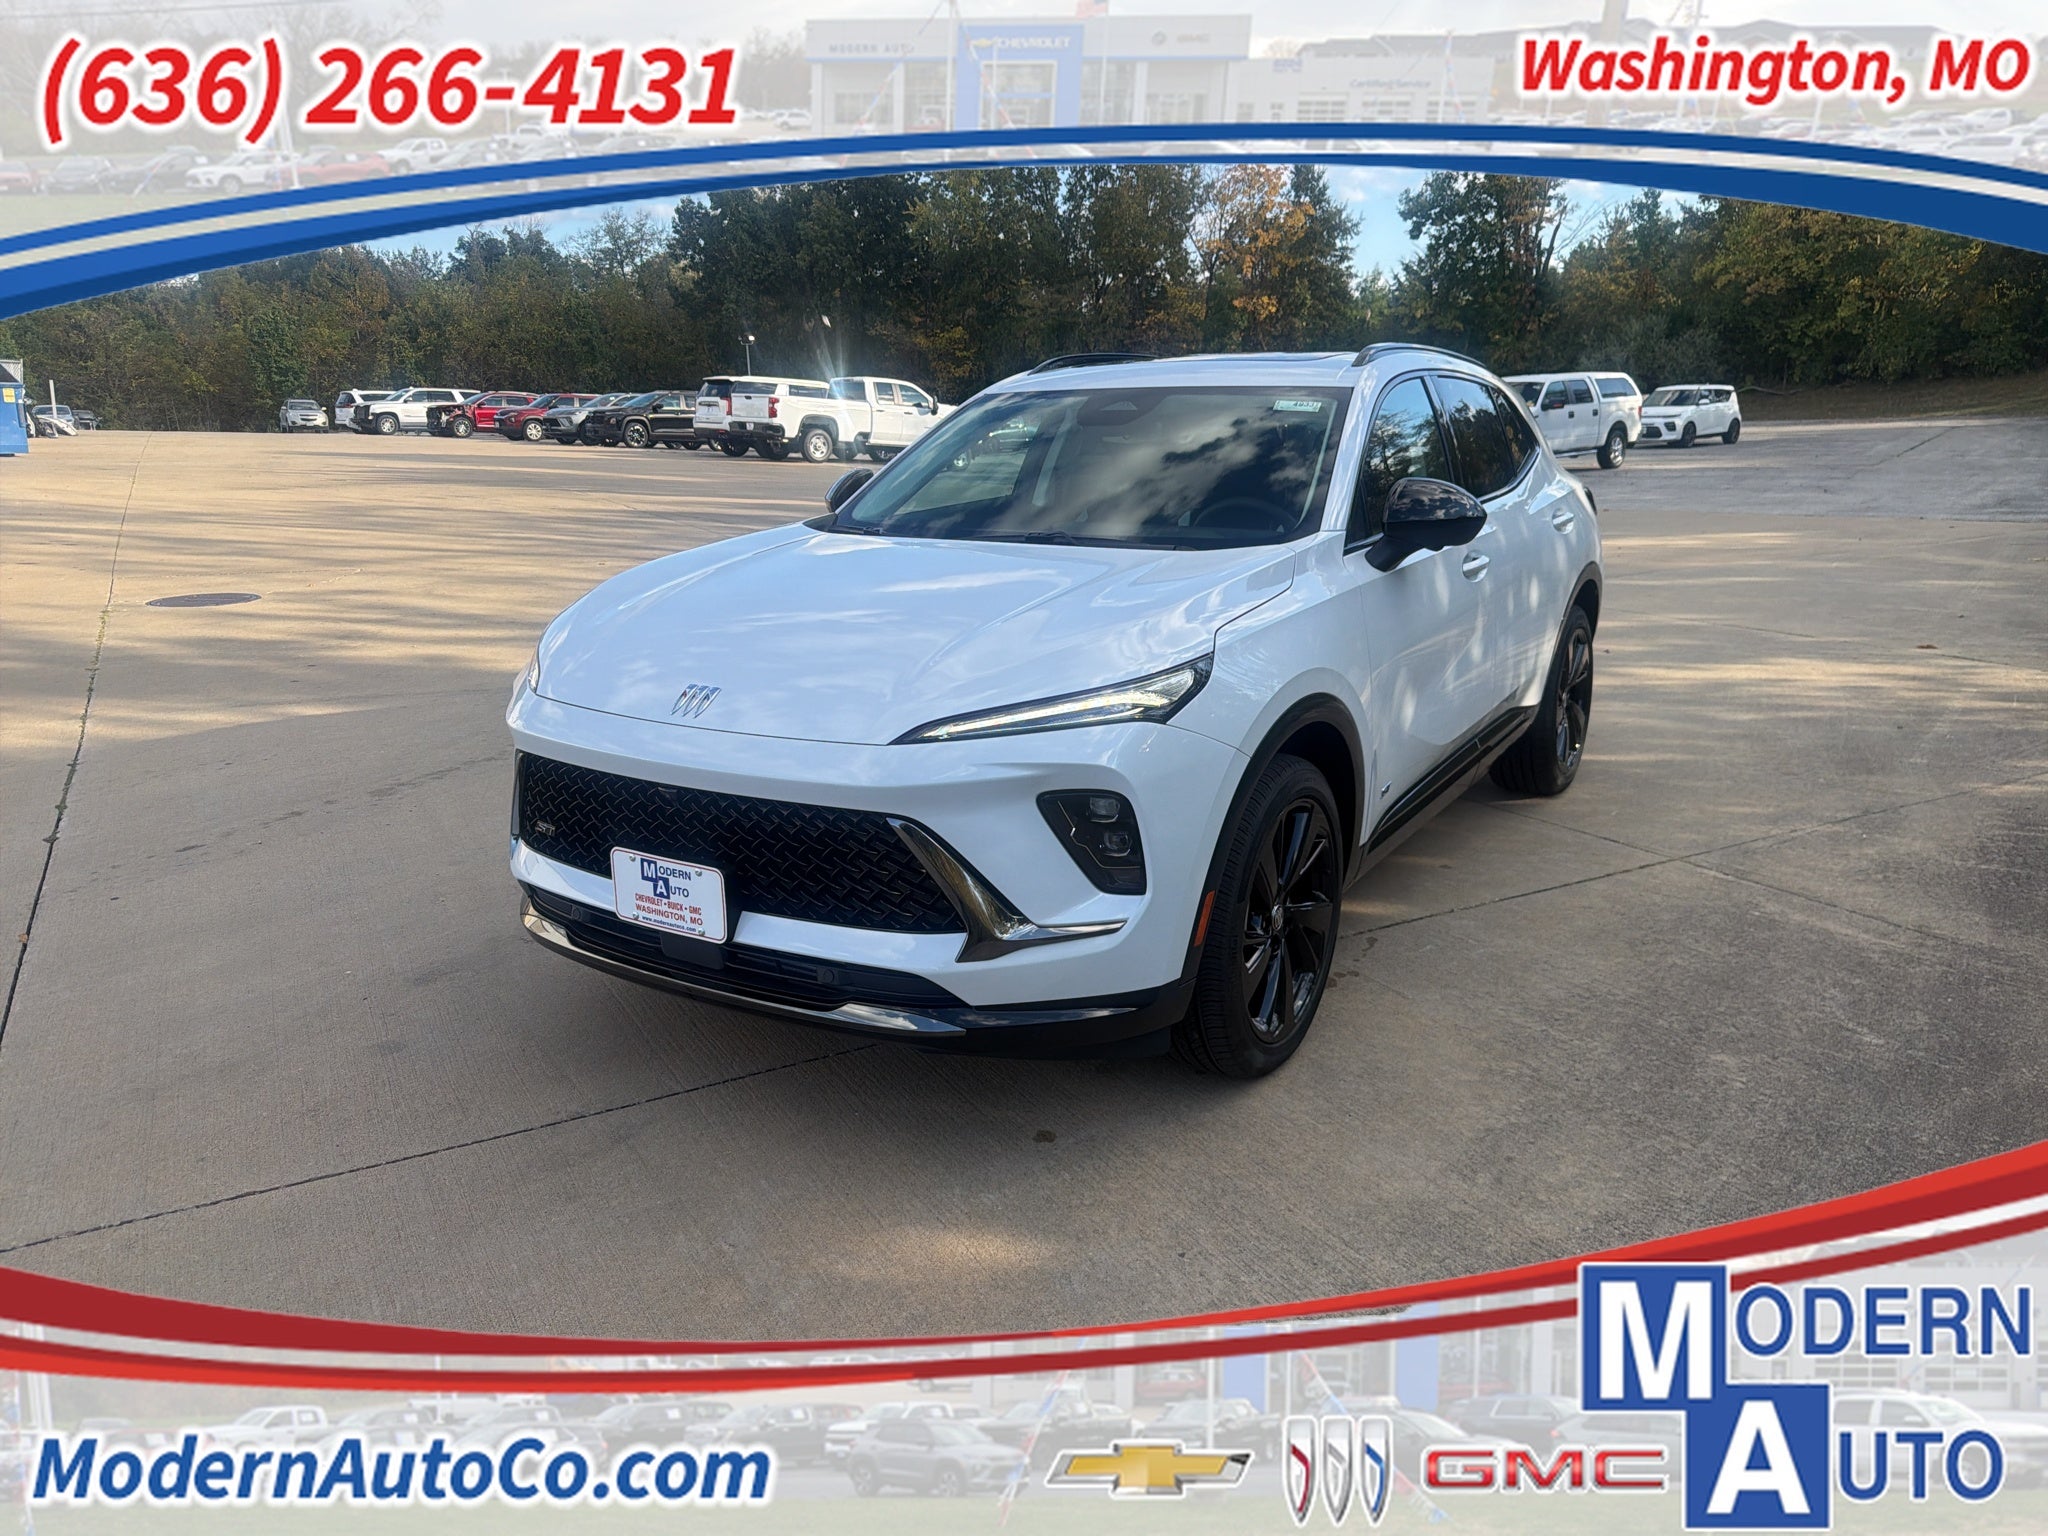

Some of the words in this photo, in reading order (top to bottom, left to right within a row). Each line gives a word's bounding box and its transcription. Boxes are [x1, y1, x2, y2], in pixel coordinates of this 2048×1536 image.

[643, 861, 692, 881] MODERN
[656, 880, 690, 898] AUTO
[635, 893, 663, 907] CHEVROLET
[667, 900, 684, 912] BUICK
[689, 905, 702, 916] GMC
[635, 903, 688, 924] WASHINGTON,
[690, 916, 703, 926] MO
